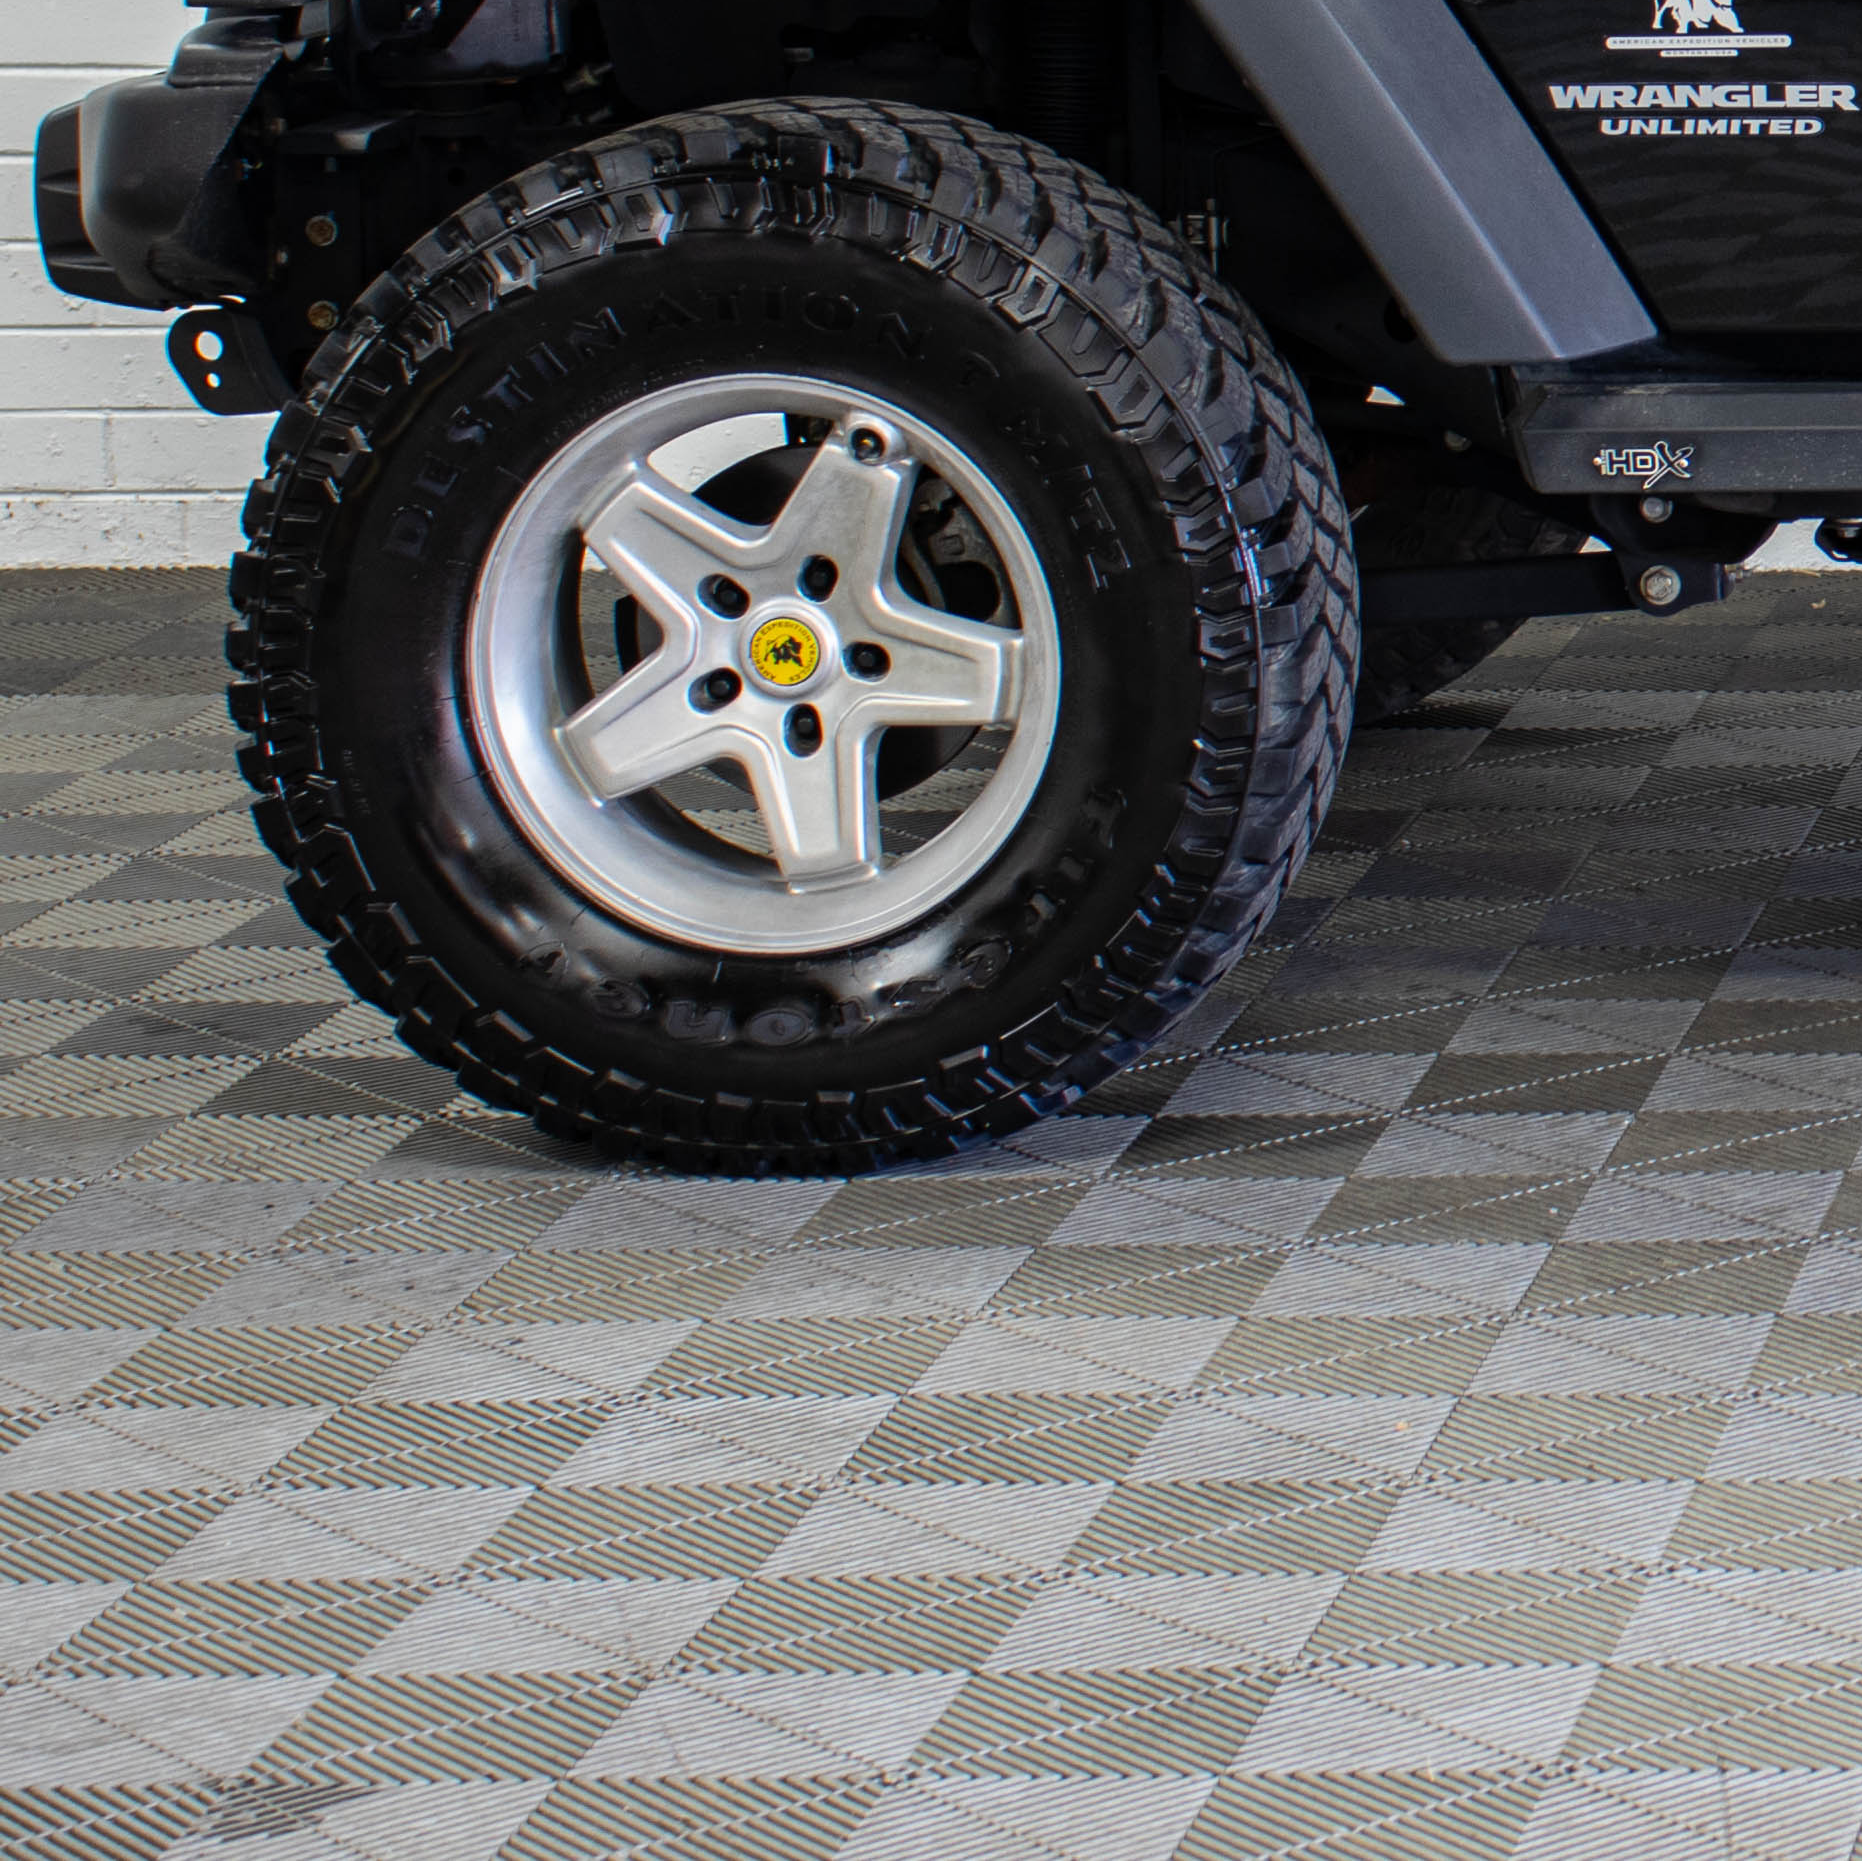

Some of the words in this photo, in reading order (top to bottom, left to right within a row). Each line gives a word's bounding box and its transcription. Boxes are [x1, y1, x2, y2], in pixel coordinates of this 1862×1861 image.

[1550, 85, 1860, 111] WRANGLER
[1601, 119, 1823, 136] UNLIMITED
[383, 284, 928, 560] DESTINATION
[1606, 441, 1695, 490] HDX
